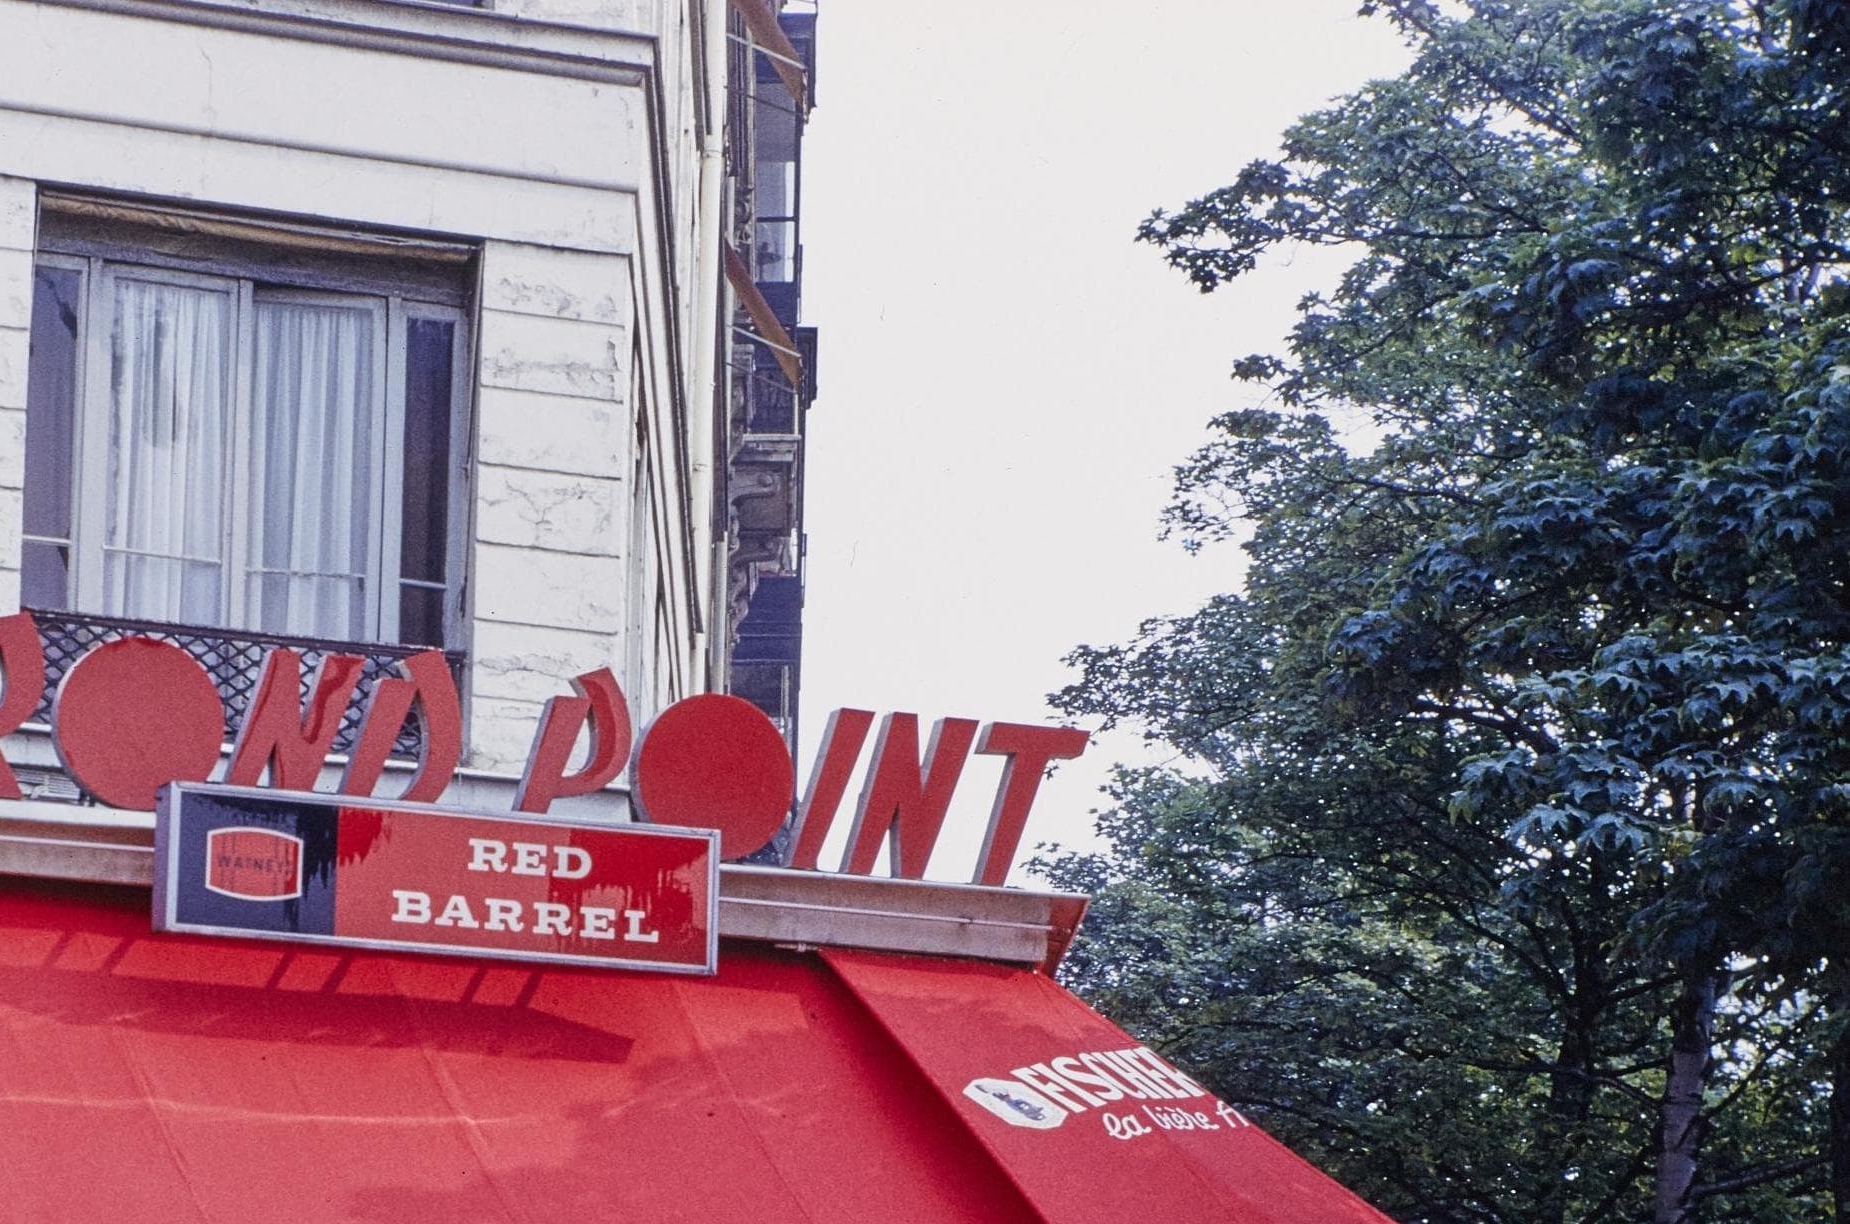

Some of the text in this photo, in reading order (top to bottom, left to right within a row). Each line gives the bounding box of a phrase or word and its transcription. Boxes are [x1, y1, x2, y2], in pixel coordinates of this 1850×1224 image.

[510, 667, 1091, 887] POINT
[467, 837, 593, 881] RED
[391, 889, 660, 944] BARREL
[1102, 1112, 1152, 1140] la
[1142, 1103, 1220, 1132] bière
